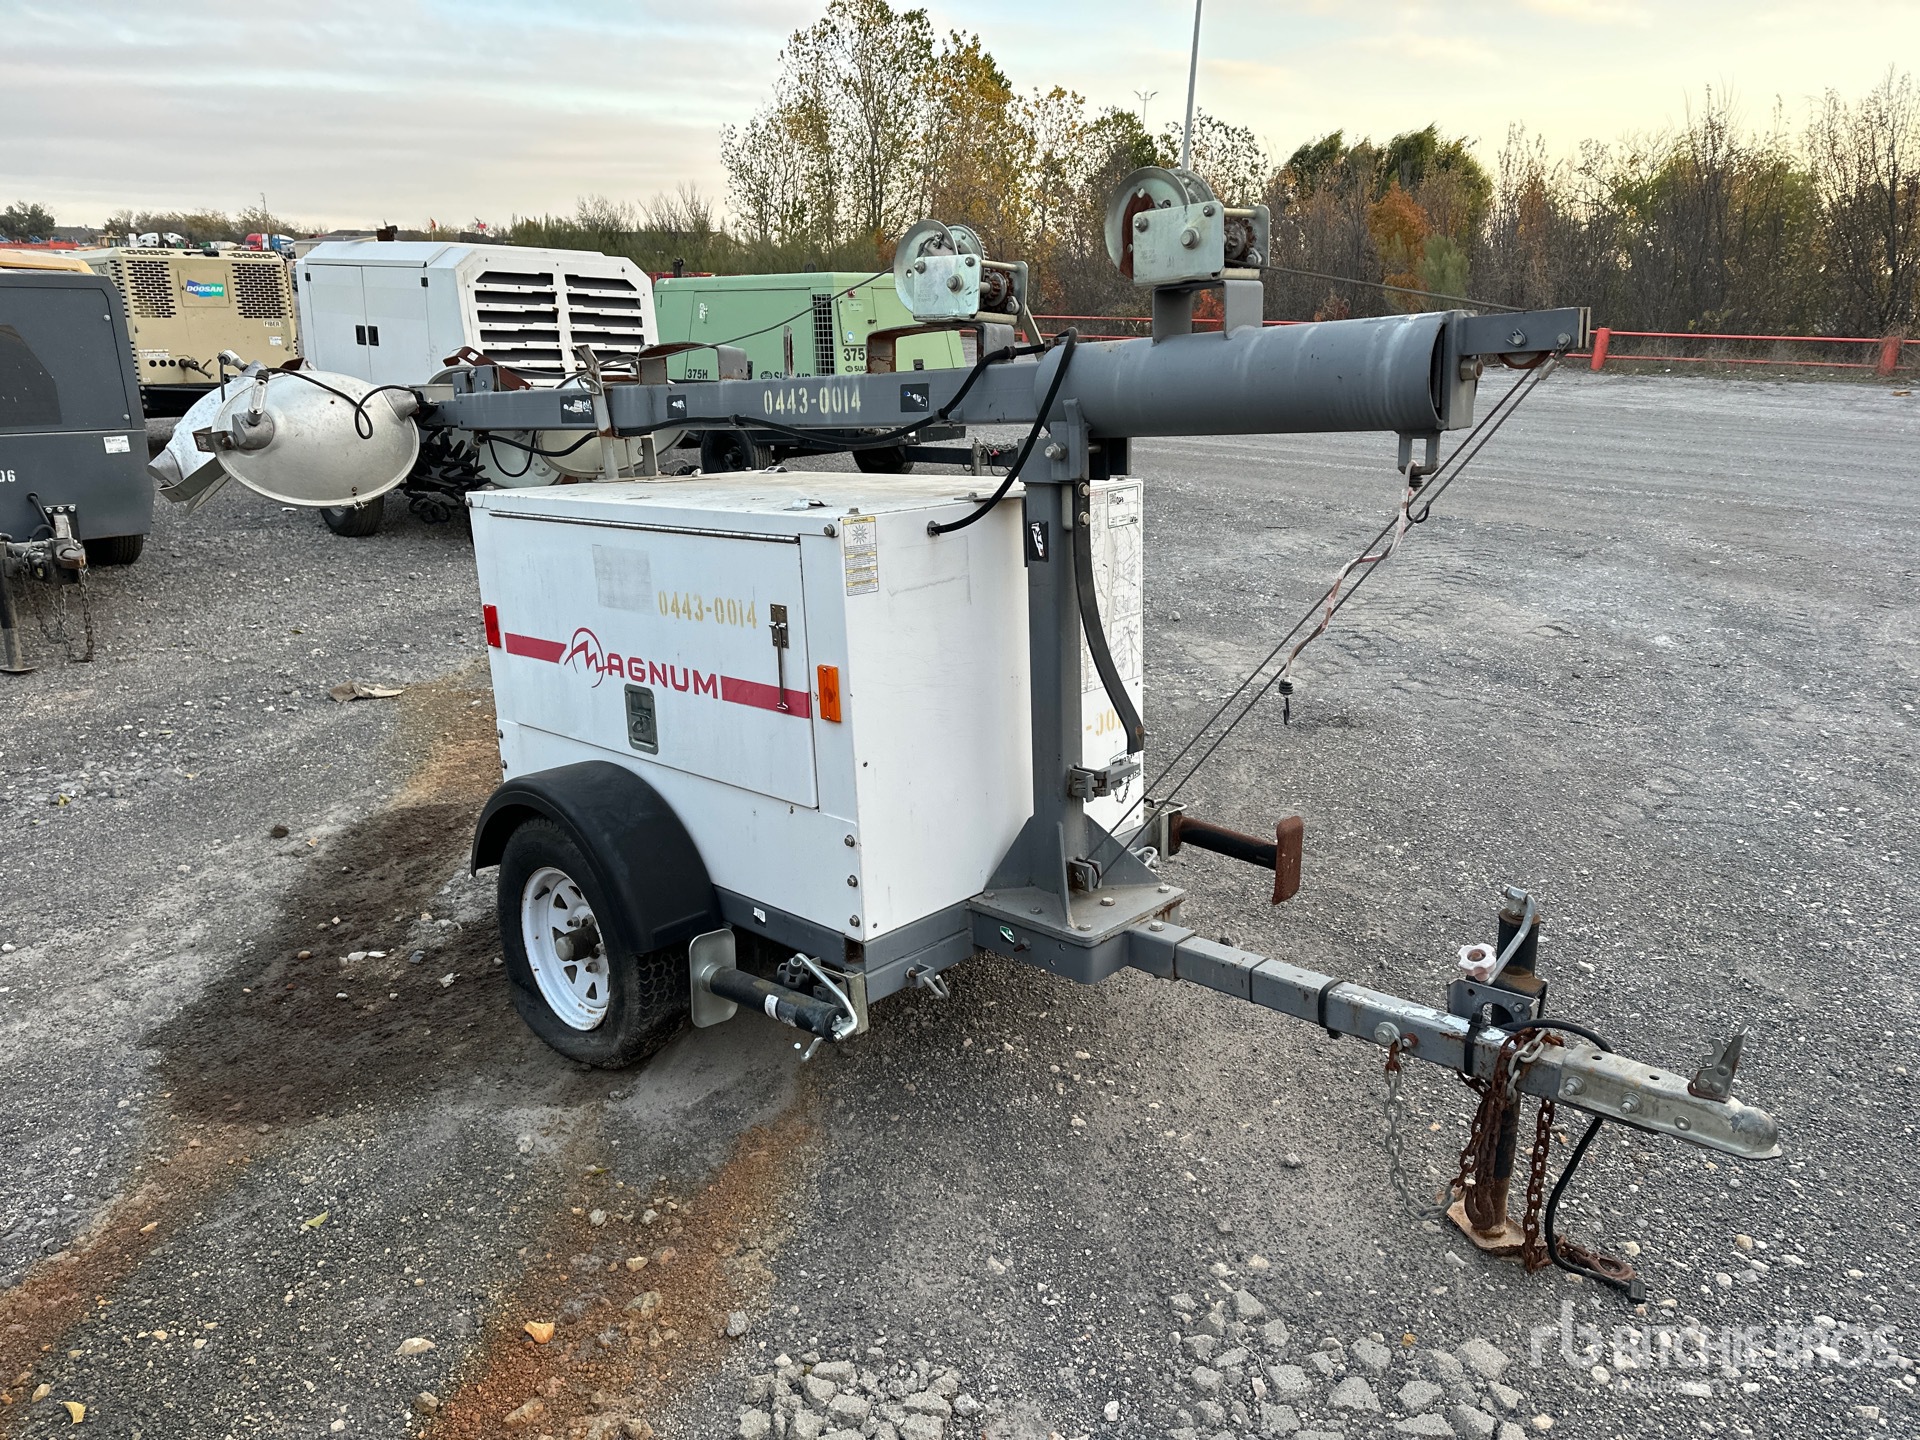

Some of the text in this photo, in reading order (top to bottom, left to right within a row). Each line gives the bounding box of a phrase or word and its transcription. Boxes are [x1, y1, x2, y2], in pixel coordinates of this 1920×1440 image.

[186, 285, 223, 293] DOOSAN
[843, 347, 866, 361] 375
[687, 368, 708, 379] 375H
[763, 384, 861, 415] 0443-0014
[658, 590, 757, 629] 0443-0014
[564, 632, 718, 699] MAGNUM
